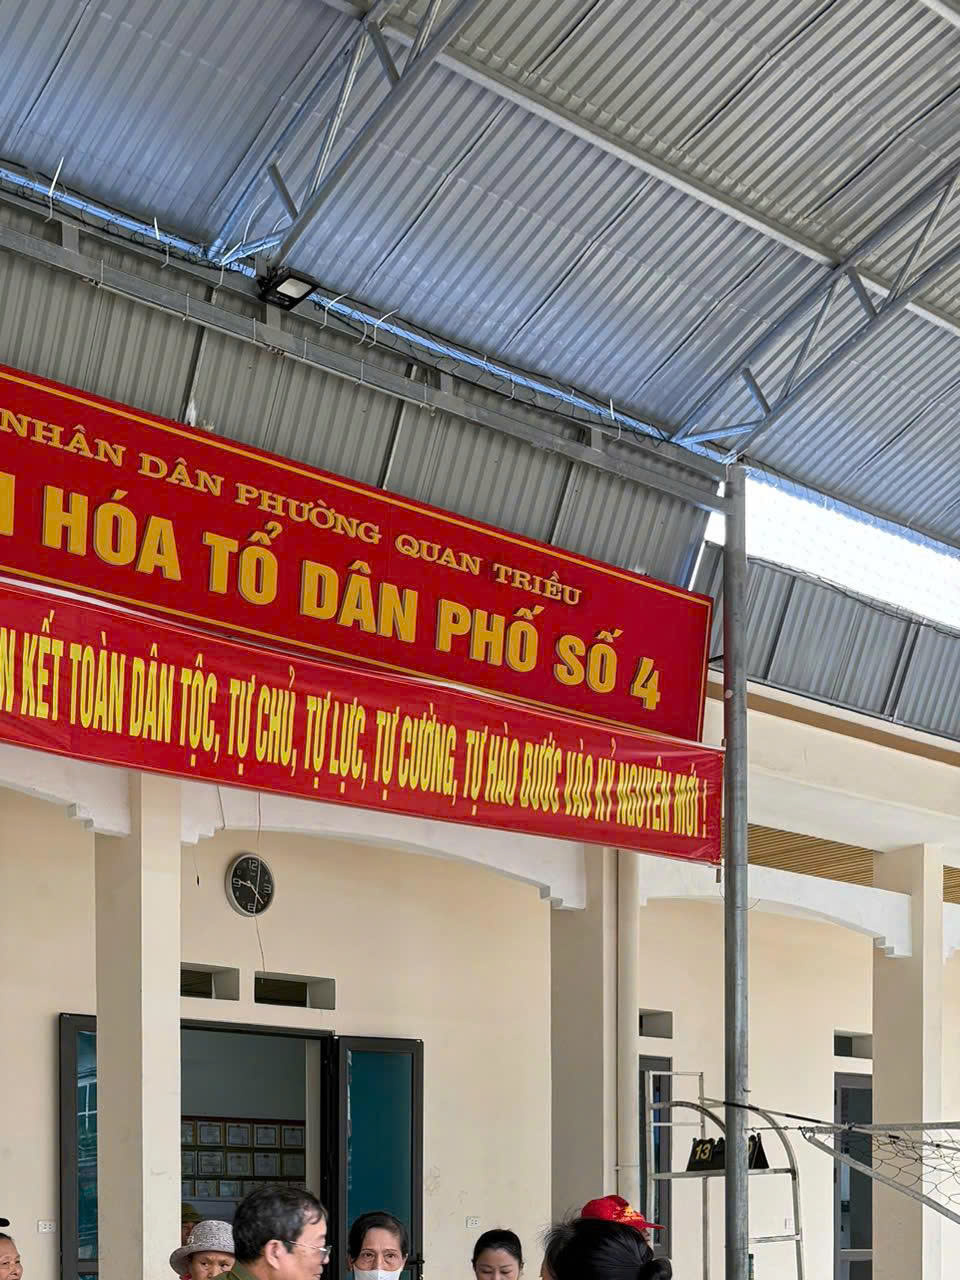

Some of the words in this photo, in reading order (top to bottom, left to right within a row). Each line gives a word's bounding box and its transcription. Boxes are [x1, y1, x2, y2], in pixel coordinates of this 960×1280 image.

[42, 485, 182, 582] HÓA
[203, 521, 284, 606] TỔ
[300, 560, 419, 644] DÂN
[435, 598, 544, 673] PHỐ
[554, 628, 623, 693] SỐ
[631, 656, 661, 710] 4
[138, 453, 224, 497] DÂN
[235, 482, 382, 545] PHƯỜNG
[395, 534, 482, 576] QUAN
[492, 563, 582, 605] TRIỀU
[21, 609, 64, 721] KẾT
[69, 631, 126, 734] TOÀN
[129, 643, 175, 743] DÂN
[179, 653, 221, 768] TỘC,
[227, 674, 256, 776] TỰ
[255, 664, 297, 777] CHỦ,
[304, 691, 331, 789] TỰ
[328, 697, 367, 793] LỰC,
[373, 706, 401, 801] TỰ
[398, 702, 457, 806] CƯỜNG,
[463, 725, 489, 816] TỰ
[485, 722, 520, 807] HÀO
[520, 731, 563, 814] BƯỚC
[564, 738, 593, 820] VÀO
[594, 737, 617, 823] KỶ
[616, 755, 672, 833] NGUYÊN
[695, 1143, 711, 1160] 13
